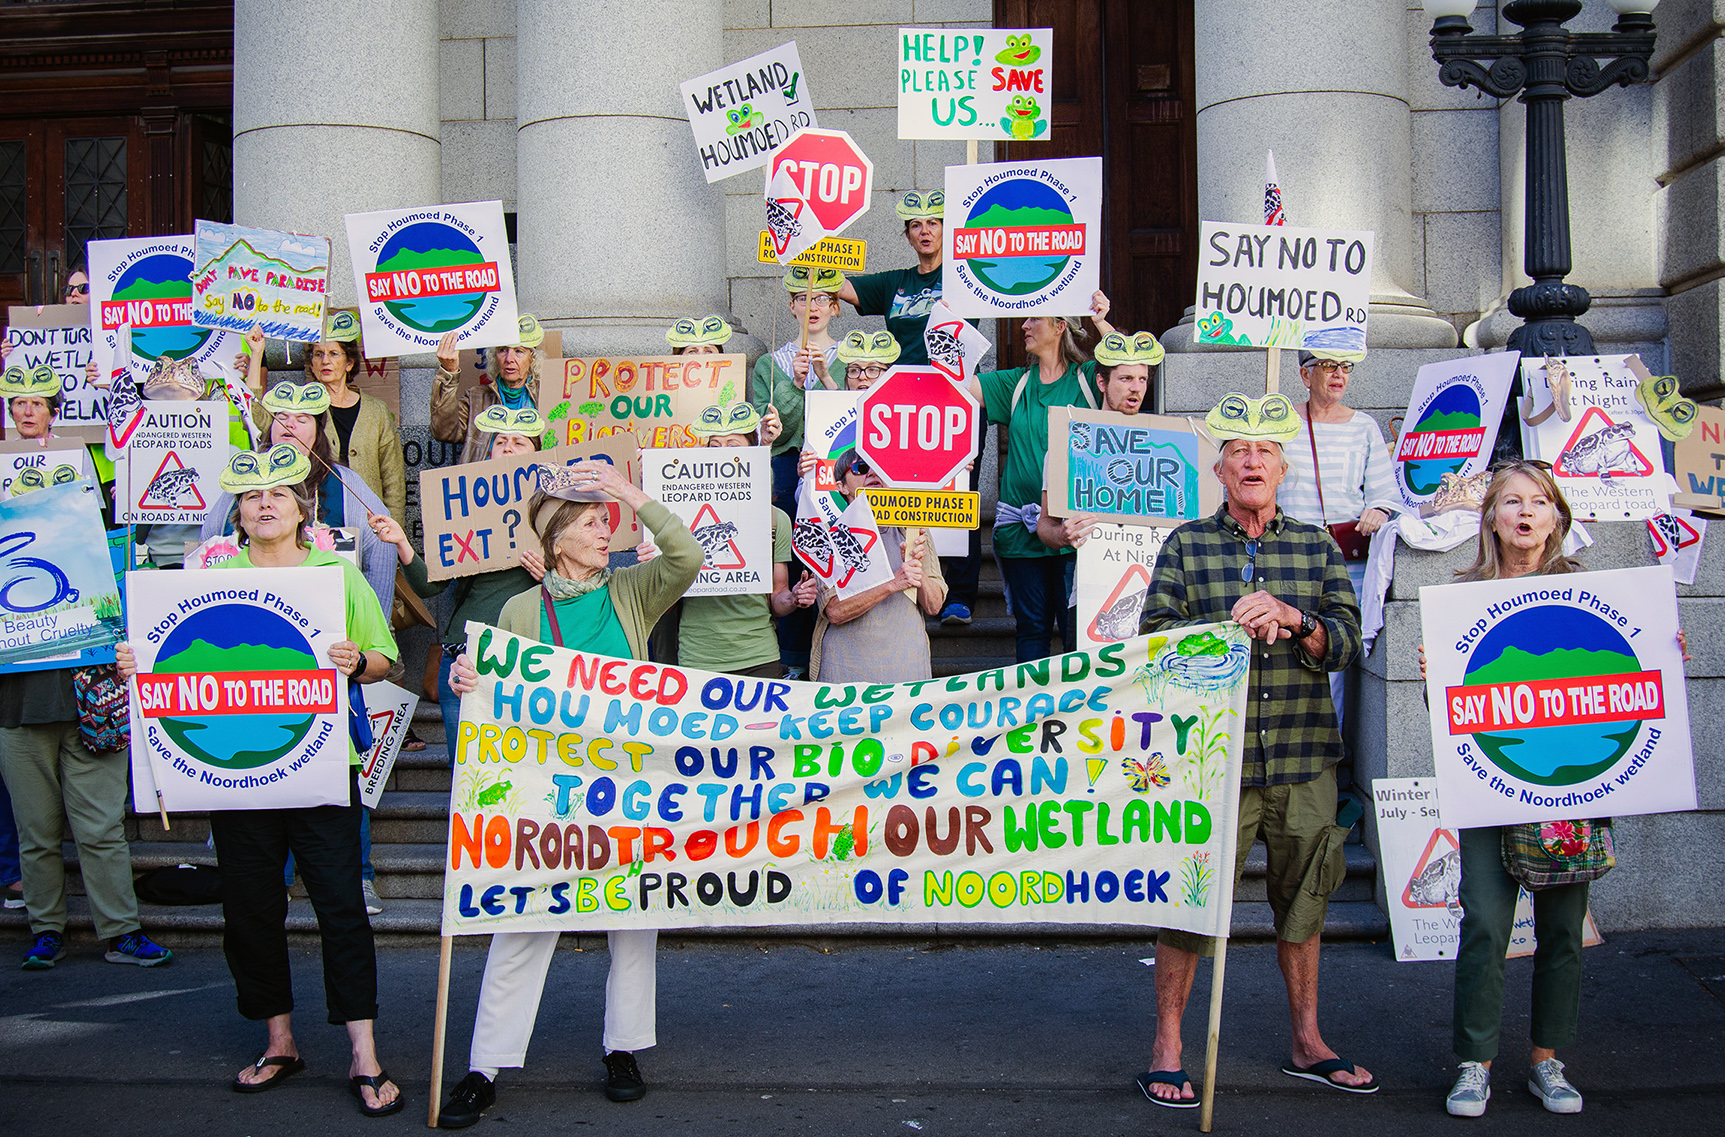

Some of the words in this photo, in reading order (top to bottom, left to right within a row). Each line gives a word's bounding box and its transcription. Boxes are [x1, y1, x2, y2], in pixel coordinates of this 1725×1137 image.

[903, 33, 984, 66] HELP!
[691, 62, 788, 114] WETLAND
[901, 69, 977, 93] PLEASE
[991, 67, 1044, 94] SAVE
[932, 95, 995, 127] US...
[700, 119, 789, 169] HOUMOED
[789, 111, 811, 132] RD
[962, 185, 984, 209] Stop
[984, 168, 1038, 187] Houmoed
[1039, 170, 1071, 195] Phase
[1069, 195, 1078, 204] 1
[369, 230, 389, 254] Stop
[387, 211, 440, 232] Houmoed
[443, 213, 475, 237] Phase
[476, 235, 484, 243] 1
[956, 234, 978, 254] SAY
[980, 228, 1007, 255] NO
[1009, 232, 1025, 252] TO
[1026, 231, 1050, 251] THE
[1051, 230, 1083, 250] ROAD
[820, 241, 853, 254] PHASE
[856, 245, 861, 255] 1
[1210, 231, 1271, 268] SAY
[1278, 236, 1317, 270] NO
[1326, 239, 1366, 275] TO
[107, 262, 128, 282] Stop
[127, 244, 178, 262] Houmoed
[194, 269, 217, 295] DONT
[228, 266, 259, 282] PAVE
[265, 272, 325, 293] PARADISE
[369, 277, 391, 297] SAY
[392, 271, 421, 297] NO
[423, 273, 440, 292] TO
[440, 272, 464, 292] THE
[465, 268, 497, 289] ROAD
[956, 264, 974, 290] Save
[973, 286, 989, 302] the
[990, 294, 1049, 310] Noordhoek
[1049, 260, 1083, 297] wetland
[104, 305, 125, 325] SAY
[127, 301, 153, 325] NO
[156, 304, 171, 322] TO
[174, 303, 192, 321] THE
[204, 294, 224, 314] Say
[232, 293, 255, 310] NO
[257, 299, 269, 312] to
[271, 299, 291, 314] the
[293, 301, 323, 319] road!
[1202, 282, 1342, 322] HOUMOED
[1345, 307, 1367, 324] RD
[374, 306, 397, 331] Save
[395, 326, 411, 341] the
[472, 296, 500, 333] wetland
[9, 328, 59, 348] DON'T
[563, 357, 732, 399] PROTECT
[1604, 376, 1638, 388] Rain
[610, 394, 674, 420] OUR
[1416, 390, 1435, 414] Stop
[1435, 373, 1472, 393] Houmoed
[1470, 375, 1487, 400] Phase
[1582, 394, 1629, 409] Night
[181, 431, 212, 439] WESTERN
[824, 415, 848, 439] Stop
[868, 403, 967, 451] STOP
[1071, 422, 1152, 455] SAVE
[132, 440, 176, 449] LEOPARD
[179, 439, 212, 449] TOADS
[1400, 437, 1419, 457] SAY
[1413, 432, 1436, 458] NO
[1432, 436, 1447, 455] TO
[1443, 433, 1463, 454] THE
[1460, 432, 1483, 453] ROAD
[13, 455, 47, 470] OUR
[661, 461, 751, 480] CAUTION
[1107, 457, 1181, 488] OUR
[662, 482, 716, 491] ENDANGERED
[717, 482, 752, 490] WESTERN
[662, 492, 712, 502] LEOPARD
[714, 491, 752, 502] TOADS
[1560, 486, 1589, 498] The
[1591, 485, 1654, 498] Western
[141, 512, 176, 521] ROADS
[178, 512, 190, 521] AT
[818, 496, 838, 523] Save
[894, 510, 973, 523] CONSTRUCTION
[925, 497, 964, 510] PHASE
[968, 498, 973, 510] 1
[1625, 500, 1657, 510] toad
[438, 528, 492, 567] EXT
[1091, 526, 1144, 546] During
[1102, 548, 1121, 561] At
[725, 571, 761, 583] AREA
[5, 614, 58, 634] Beauty
[40, 622, 93, 641] Cruelty
[147, 612, 178, 645] Stop
[177, 589, 259, 614] Houmoed
[263, 592, 309, 628] Phase
[310, 627, 322, 639] 1
[1455, 619, 1488, 654] Stop
[1487, 588, 1574, 619] Houmoed
[1578, 590, 1629, 628] Phase
[1630, 626, 1643, 639] 1
[475, 628, 555, 683] WE
[566, 654, 689, 706] NEED
[701, 677, 792, 712] OUR
[813, 643, 1126, 708] WETLANDS
[141, 682, 173, 710] SAY
[178, 675, 219, 711] NO
[223, 680, 247, 707] TO
[250, 679, 285, 706] THE
[288, 678, 333, 706] ROAD
[493, 681, 591, 729] HOU
[1452, 694, 1487, 726] SAY
[1490, 684, 1536, 726] NO
[1539, 689, 1566, 718] TO
[1567, 684, 1606, 717] THE
[1608, 681, 1660, 713] ROAD
[148, 725, 172, 761] Save
[172, 756, 197, 778] the
[199, 768, 289, 789] Noordhoek
[289, 720, 335, 771] wetland
[365, 736, 395, 795] BREEDING
[391, 702, 410, 735] AREA
[457, 720, 654, 772] PROTECT
[674, 745, 776, 780] OUR
[1456, 742, 1488, 781] Save
[1488, 777, 1516, 798] the
[1519, 781, 1615, 807] Noordhoek
[1615, 727, 1663, 787] wetland
[552, 774, 830, 822] TOGETHER
[863, 763, 939, 799] WE
[956, 756, 1069, 797] CAN
[1375, 788, 1431, 802] Winter
[1380, 807, 1407, 820] July
[451, 812, 512, 871] NO
[515, 822, 612, 872] ROAD
[884, 804, 994, 857] OUR
[1003, 799, 1213, 853] WETLAND
[458, 881, 571, 919] LET'S
[575, 875, 632, 914] BE
[639, 870, 793, 912] PROUD
[853, 868, 910, 906] OF
[923, 868, 1172, 909] NOORDHOEK
[1412, 918, 1439, 931] The
